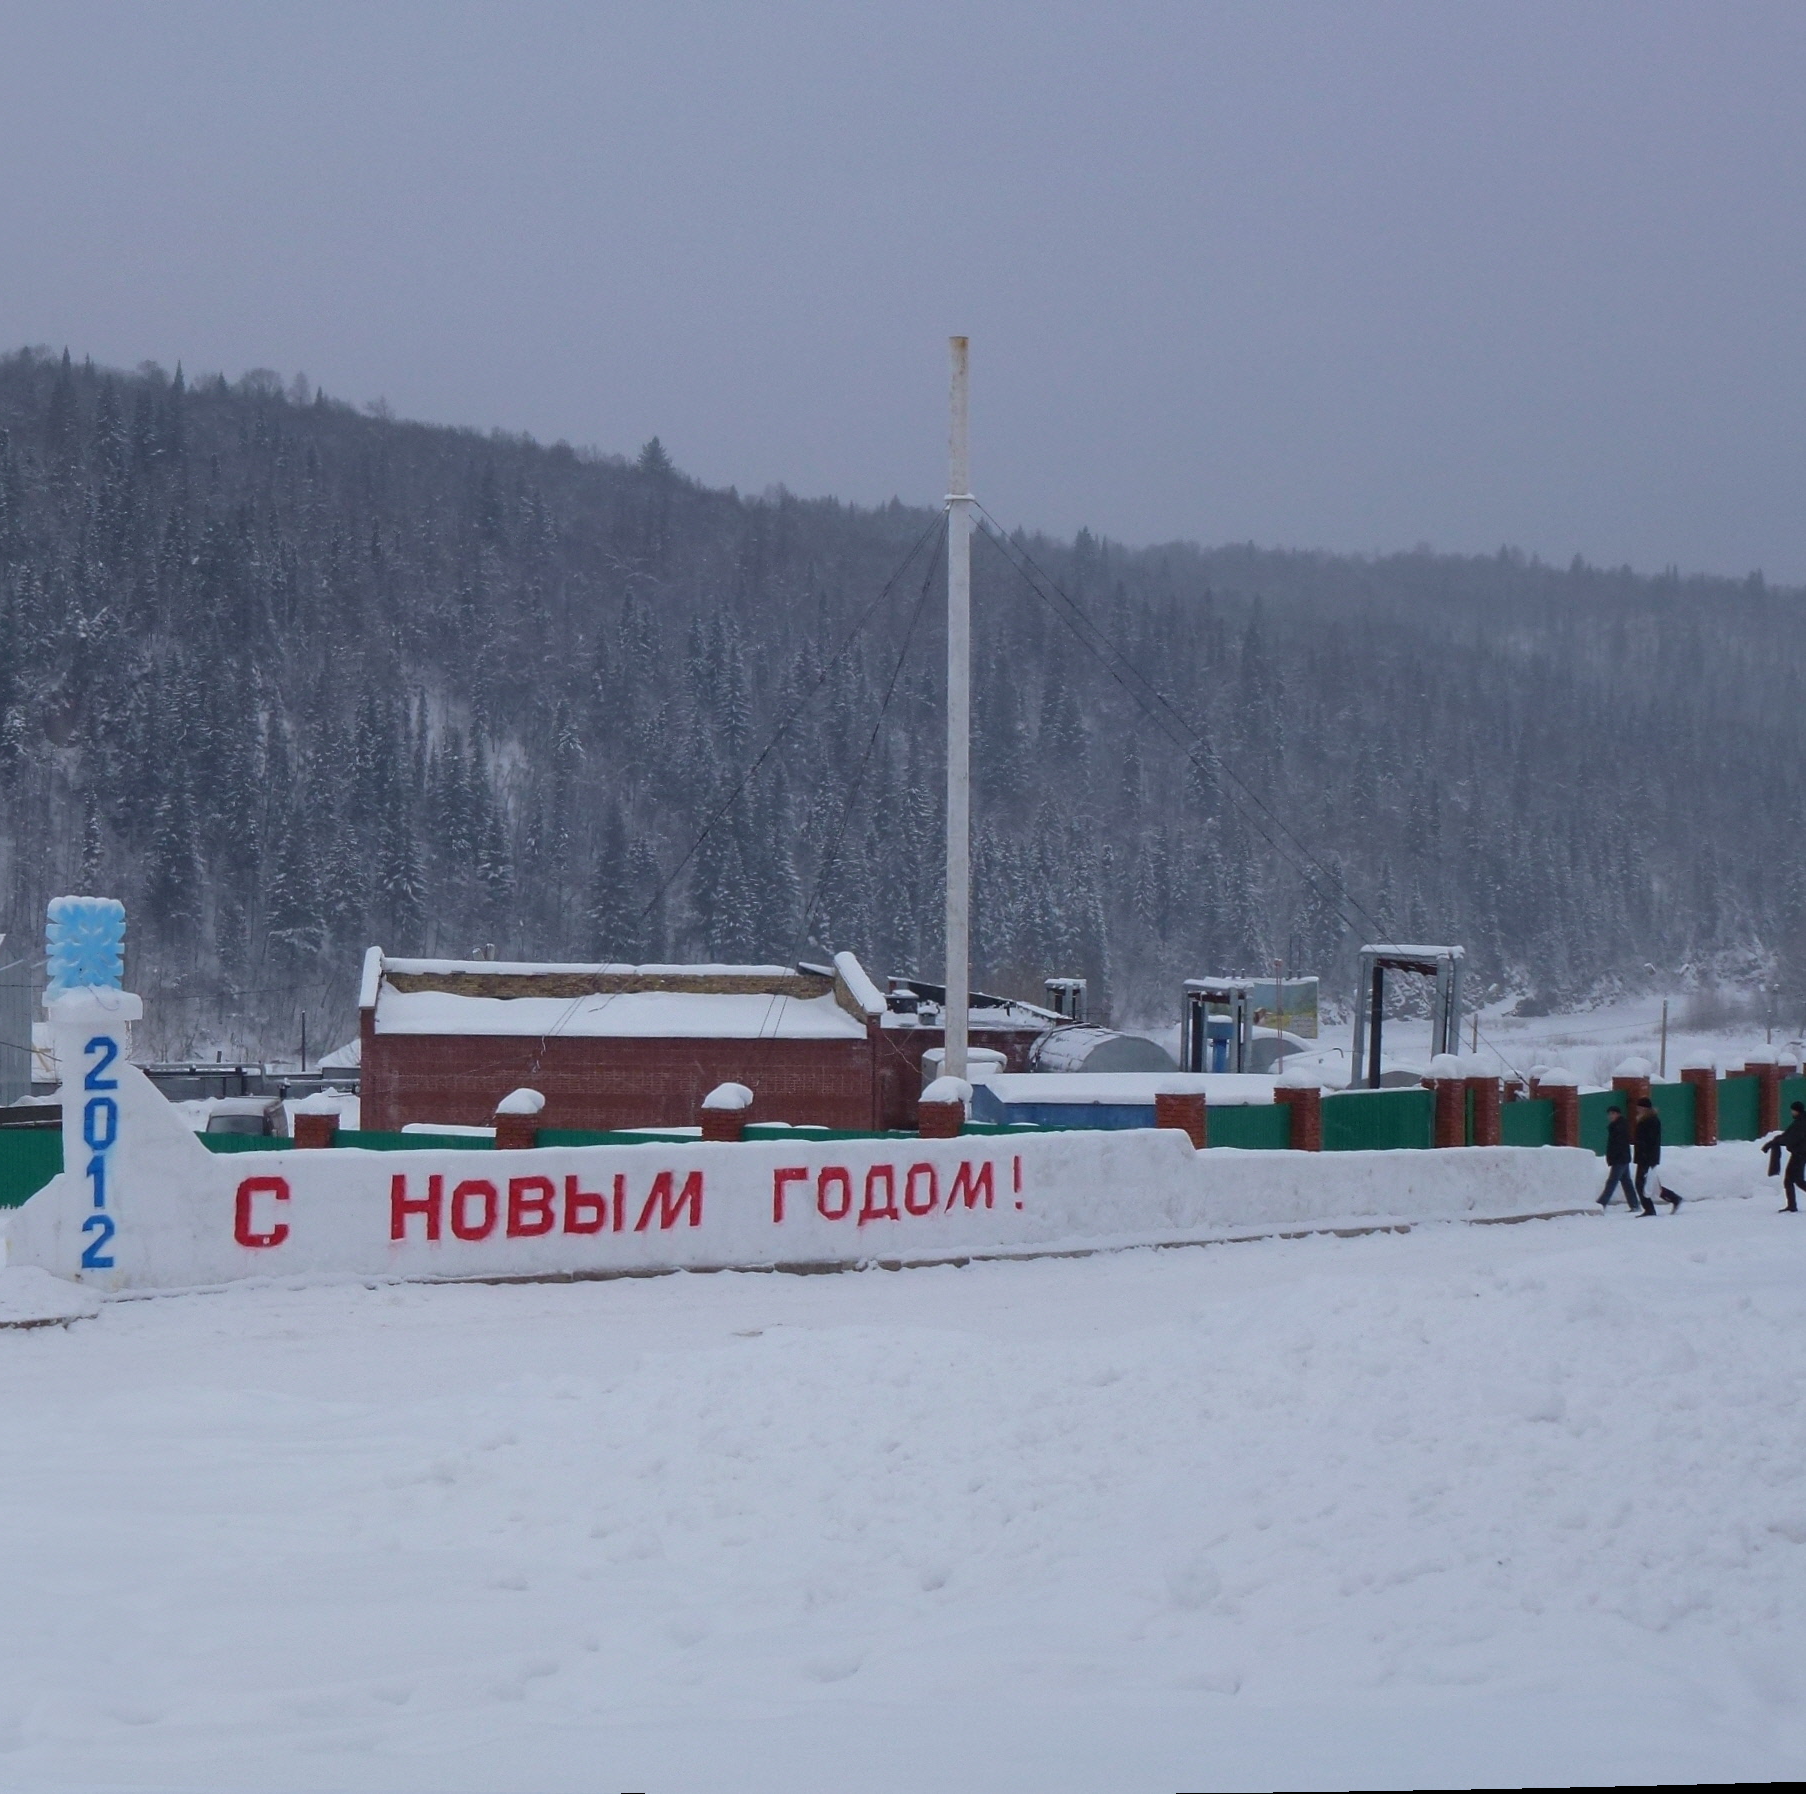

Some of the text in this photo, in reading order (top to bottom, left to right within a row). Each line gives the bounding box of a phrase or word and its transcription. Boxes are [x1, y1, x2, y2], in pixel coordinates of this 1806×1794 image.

[80, 1034, 123, 1270] 2012
[233, 1175, 292, 1250] С
[389, 1170, 705, 1242] НОВЫМ
